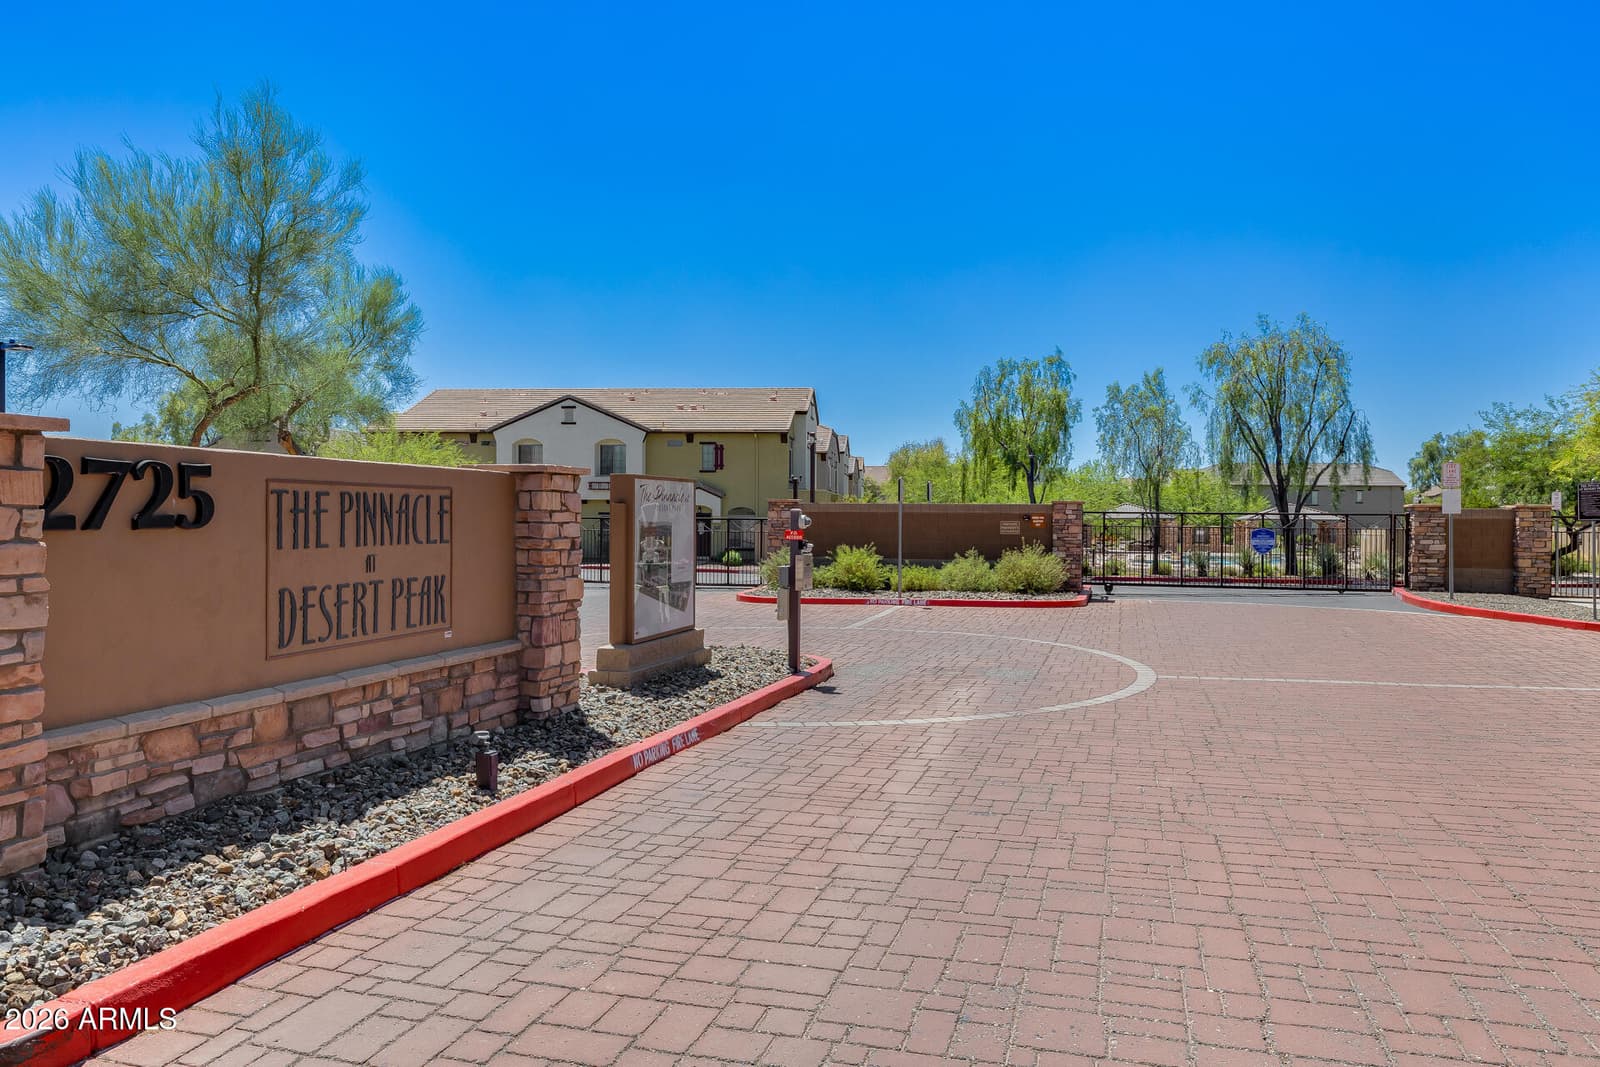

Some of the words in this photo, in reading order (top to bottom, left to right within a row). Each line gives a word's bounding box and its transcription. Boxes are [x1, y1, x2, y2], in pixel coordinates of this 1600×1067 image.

[43, 455, 215, 530] 2725
[271, 488, 330, 550] THE
[339, 491, 451, 548] PINNACLE
[365, 554, 376, 573] AT
[278, 580, 384, 649] DESERT
[391, 574, 447, 631] PEAK
[632, 752, 644, 771] NO
[644, 740, 671, 767] PARKING
